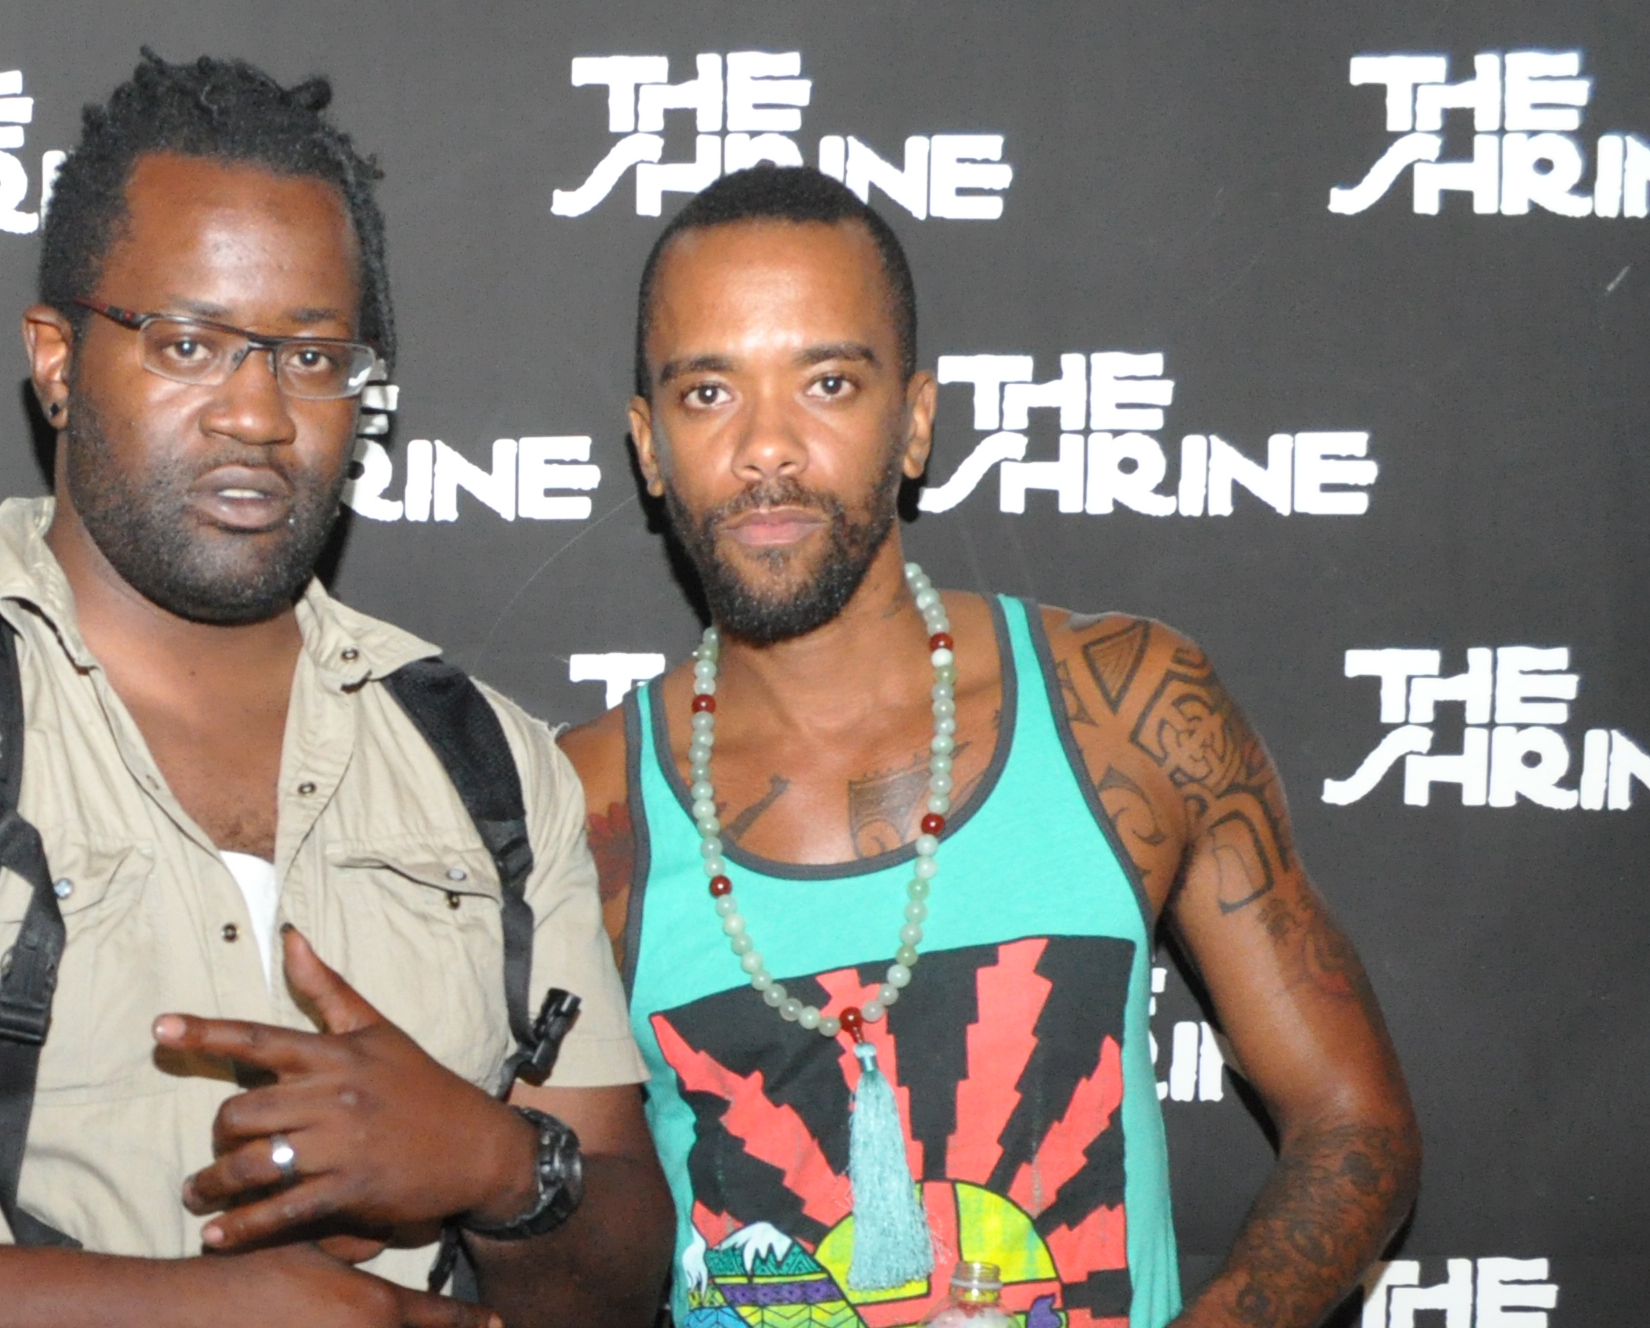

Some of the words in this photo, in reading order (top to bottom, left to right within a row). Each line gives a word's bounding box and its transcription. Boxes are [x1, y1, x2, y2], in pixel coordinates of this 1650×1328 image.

[570, 49, 814, 133] THE
[1348, 48, 1593, 133] THE
[936, 350, 1176, 431] THE
[916, 429, 1380, 518] SHRINE
[1343, 645, 1580, 725] THE
